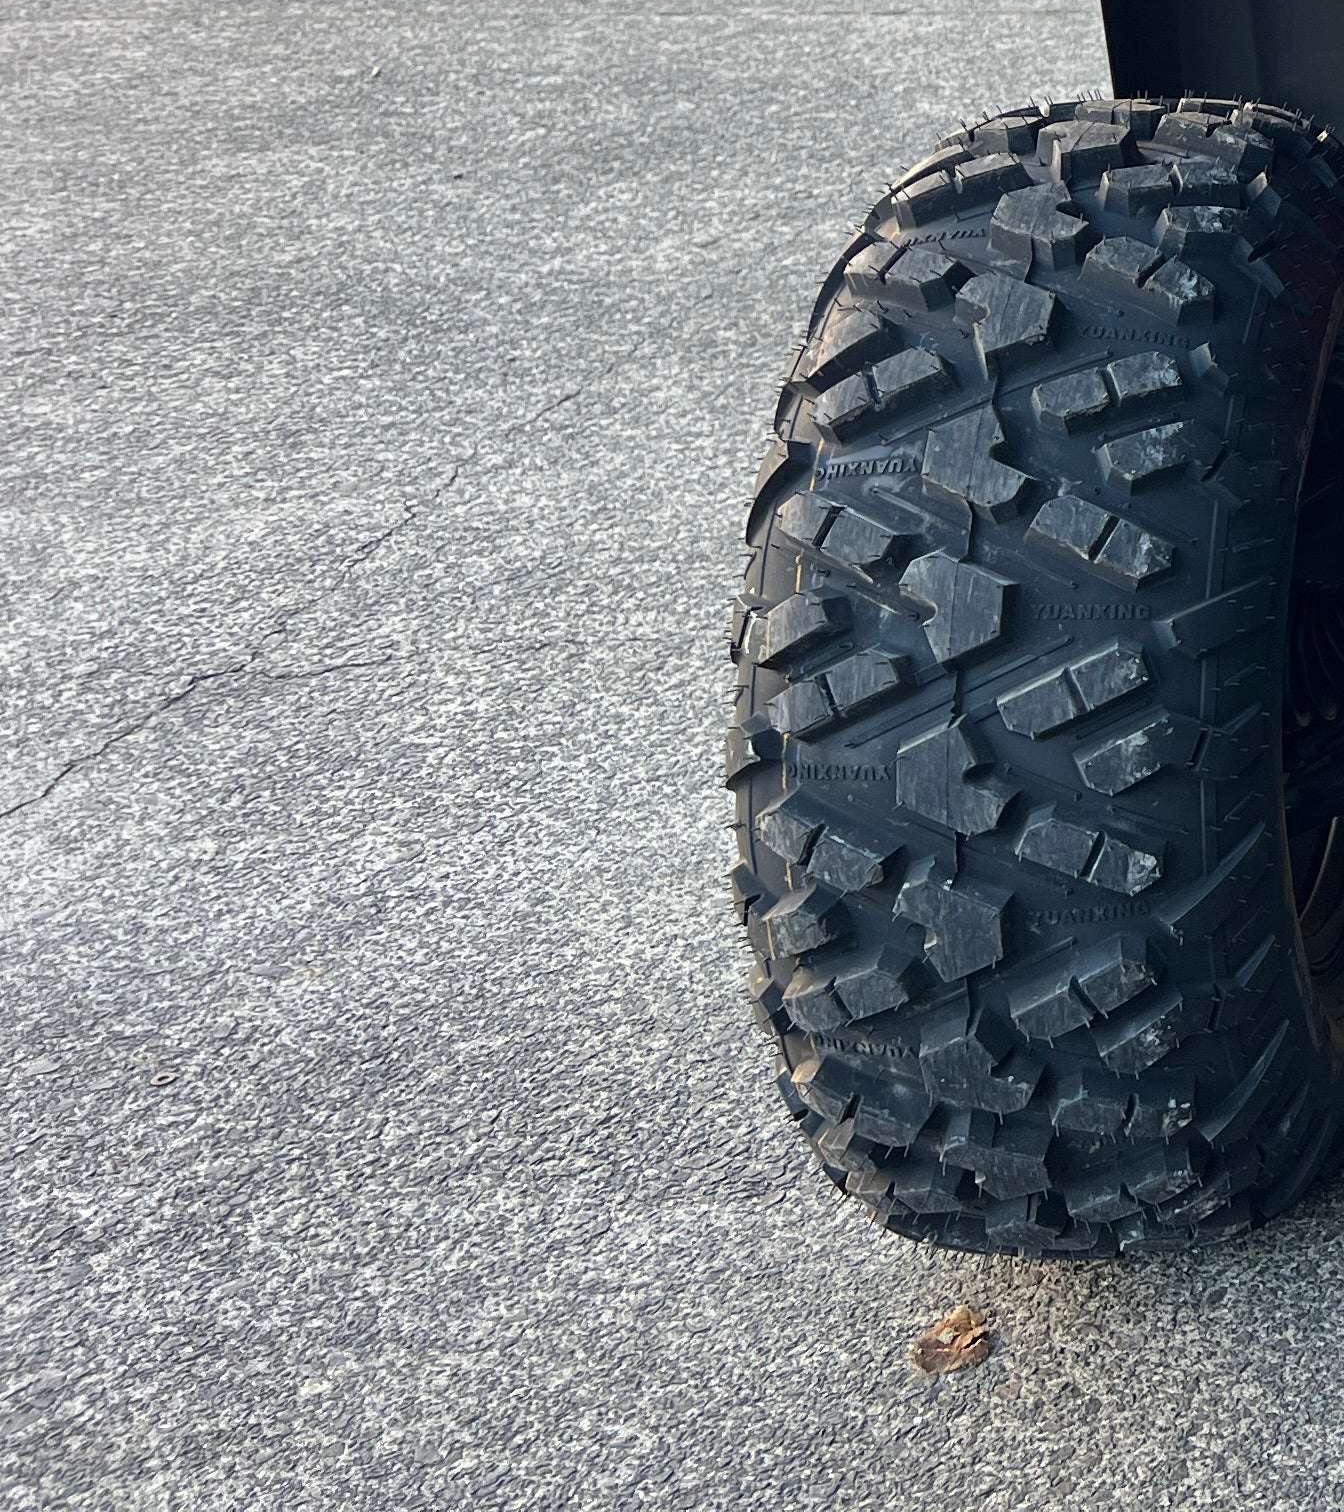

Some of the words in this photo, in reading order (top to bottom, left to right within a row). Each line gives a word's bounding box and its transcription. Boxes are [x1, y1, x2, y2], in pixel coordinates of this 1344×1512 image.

[1078, 325, 1191, 350] YUANXING
[815, 455, 920, 480] YUANXING
[1030, 603, 1152, 621] YUANXING
[1030, 900, 1151, 926] YUANXING
